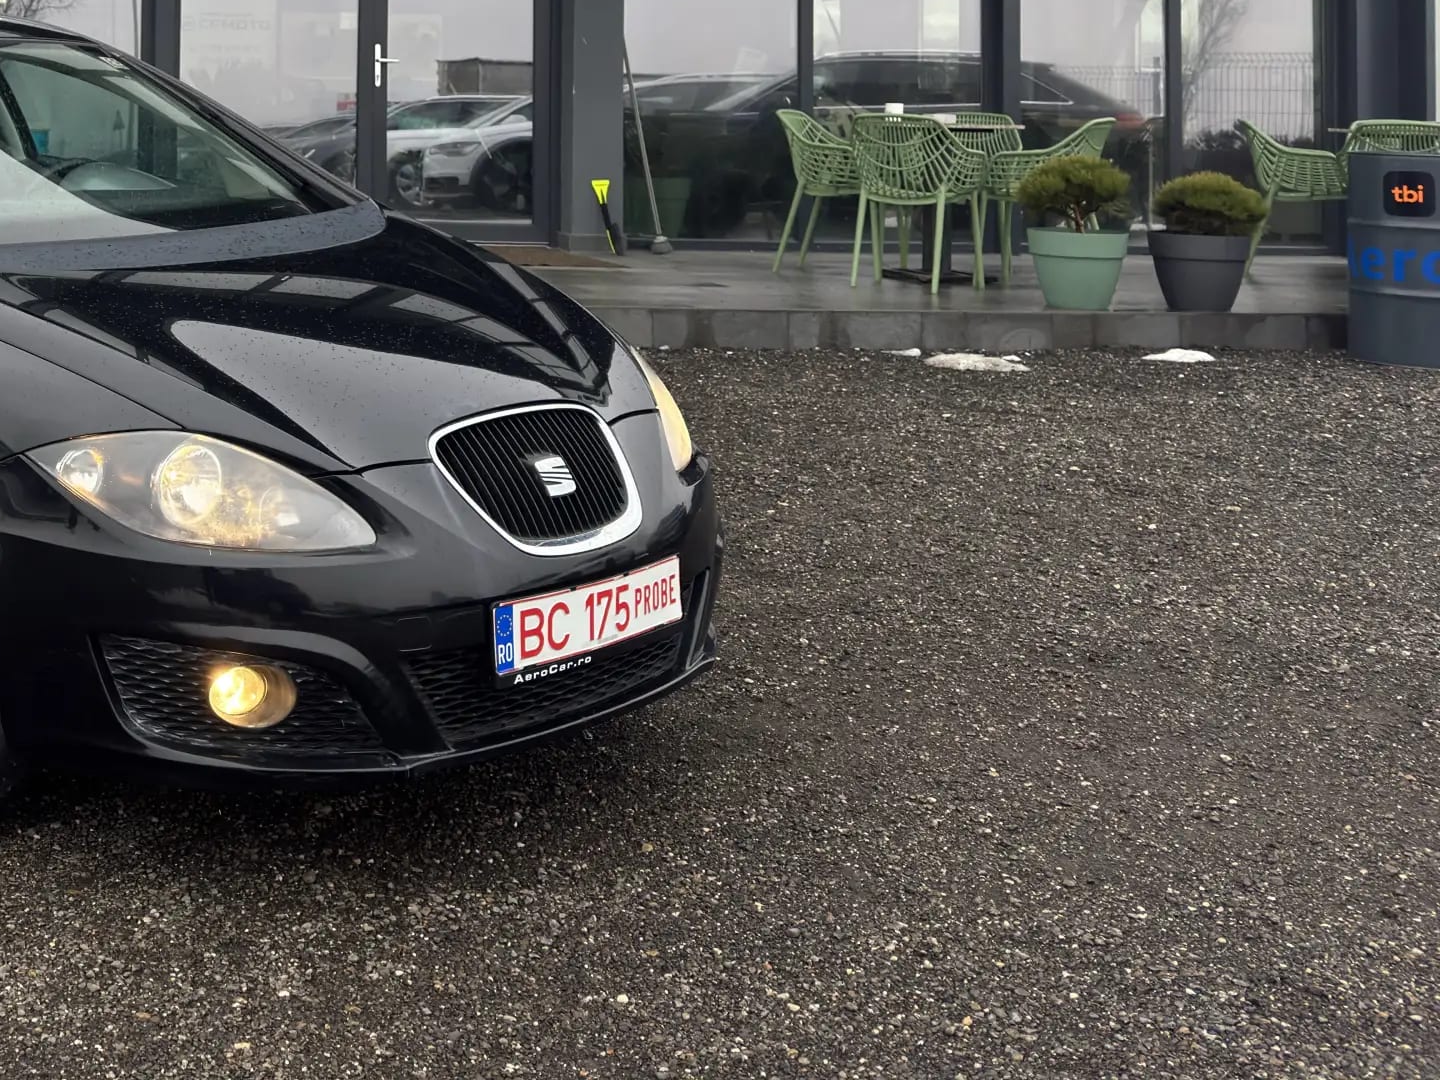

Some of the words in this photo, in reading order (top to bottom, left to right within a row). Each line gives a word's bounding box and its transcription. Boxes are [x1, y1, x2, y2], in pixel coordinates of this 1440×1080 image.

[1391, 184, 1424, 204] tbi
[520, 601, 570, 660] BC
[585, 583, 631, 641] 175
[634, 573, 677, 618] PROBE
[498, 642, 513, 665] RO
[513, 655, 592, 685] AeroCar.ro
